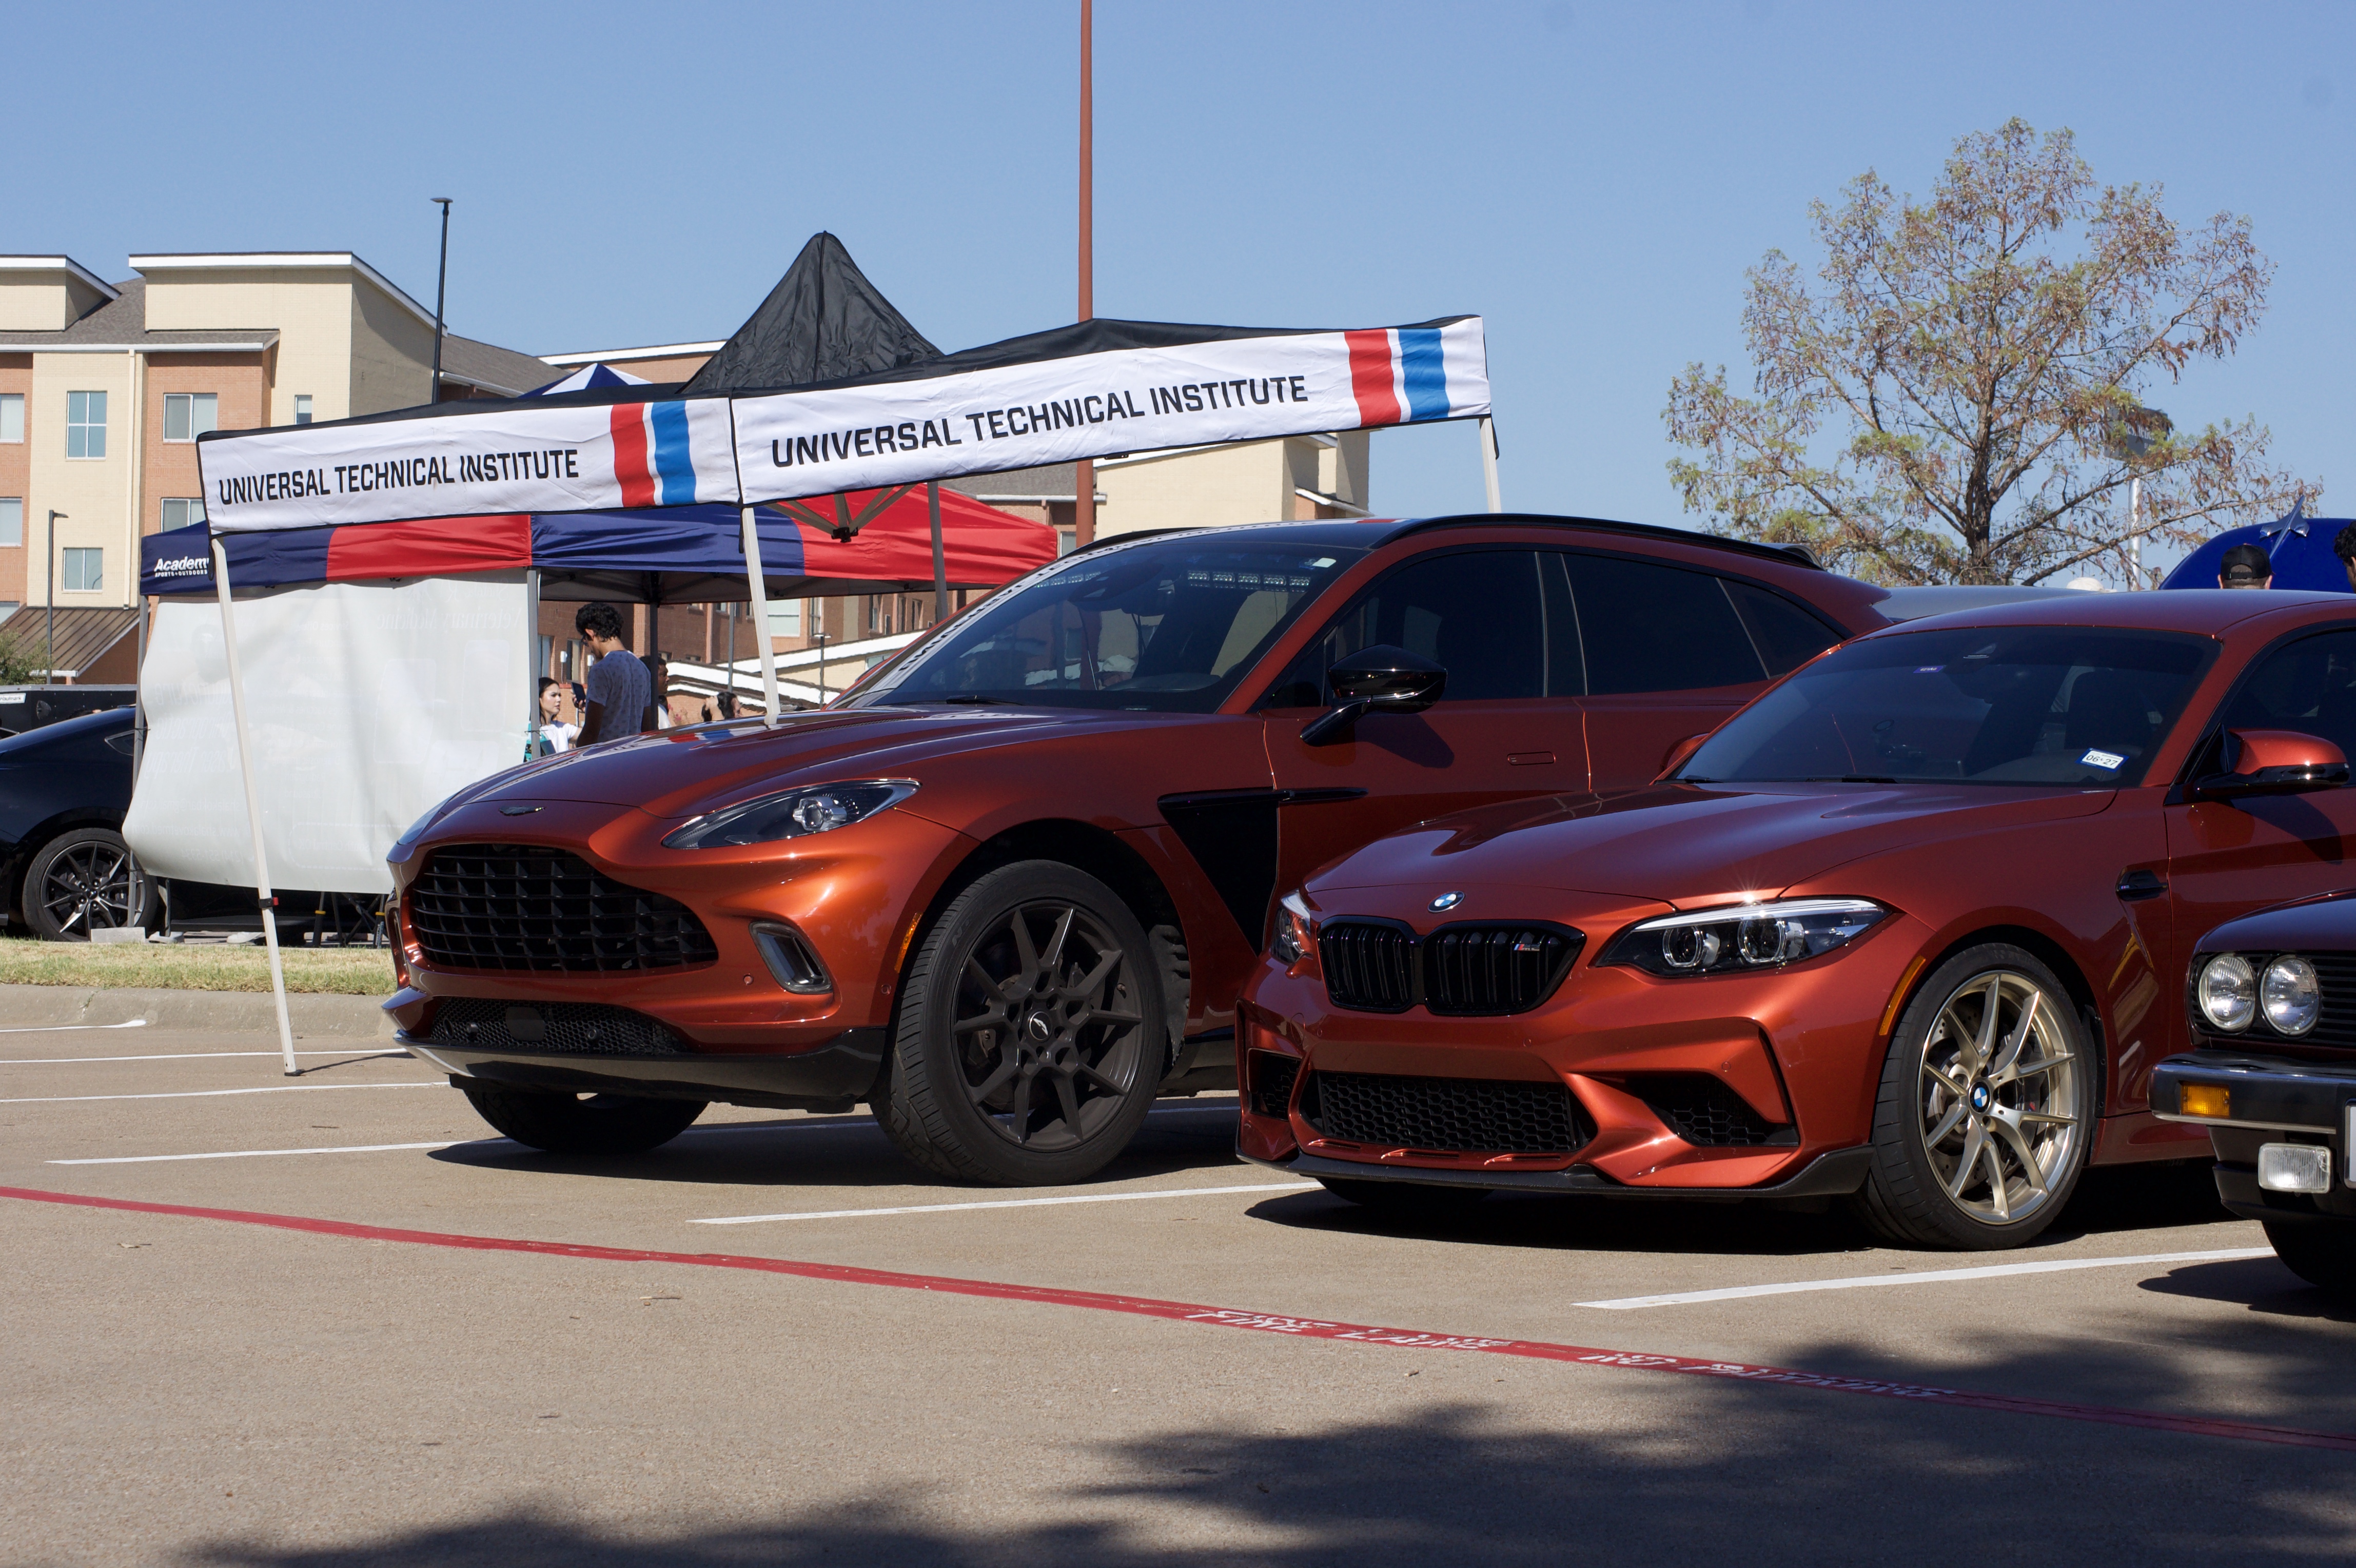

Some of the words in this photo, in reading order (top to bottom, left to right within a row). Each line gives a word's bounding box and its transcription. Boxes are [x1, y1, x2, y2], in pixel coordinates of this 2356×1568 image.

[773, 419, 961, 467] UNIVERSAL
[965, 391, 1145, 441] TECHNICAL
[1150, 376, 1308, 415] INSTITUTE
[219, 469, 330, 505] UNIVERSAL
[335, 456, 455, 493] TECHNICAL
[460, 449, 578, 482] INSTITUTE
[154, 556, 209, 572] Academ
[1185, 1310, 1338, 1332] FIRE
[1334, 1329, 1515, 1349] LANE
[1577, 1353, 1677, 1365] NO
[1677, 1363, 1956, 1397] PARKING
